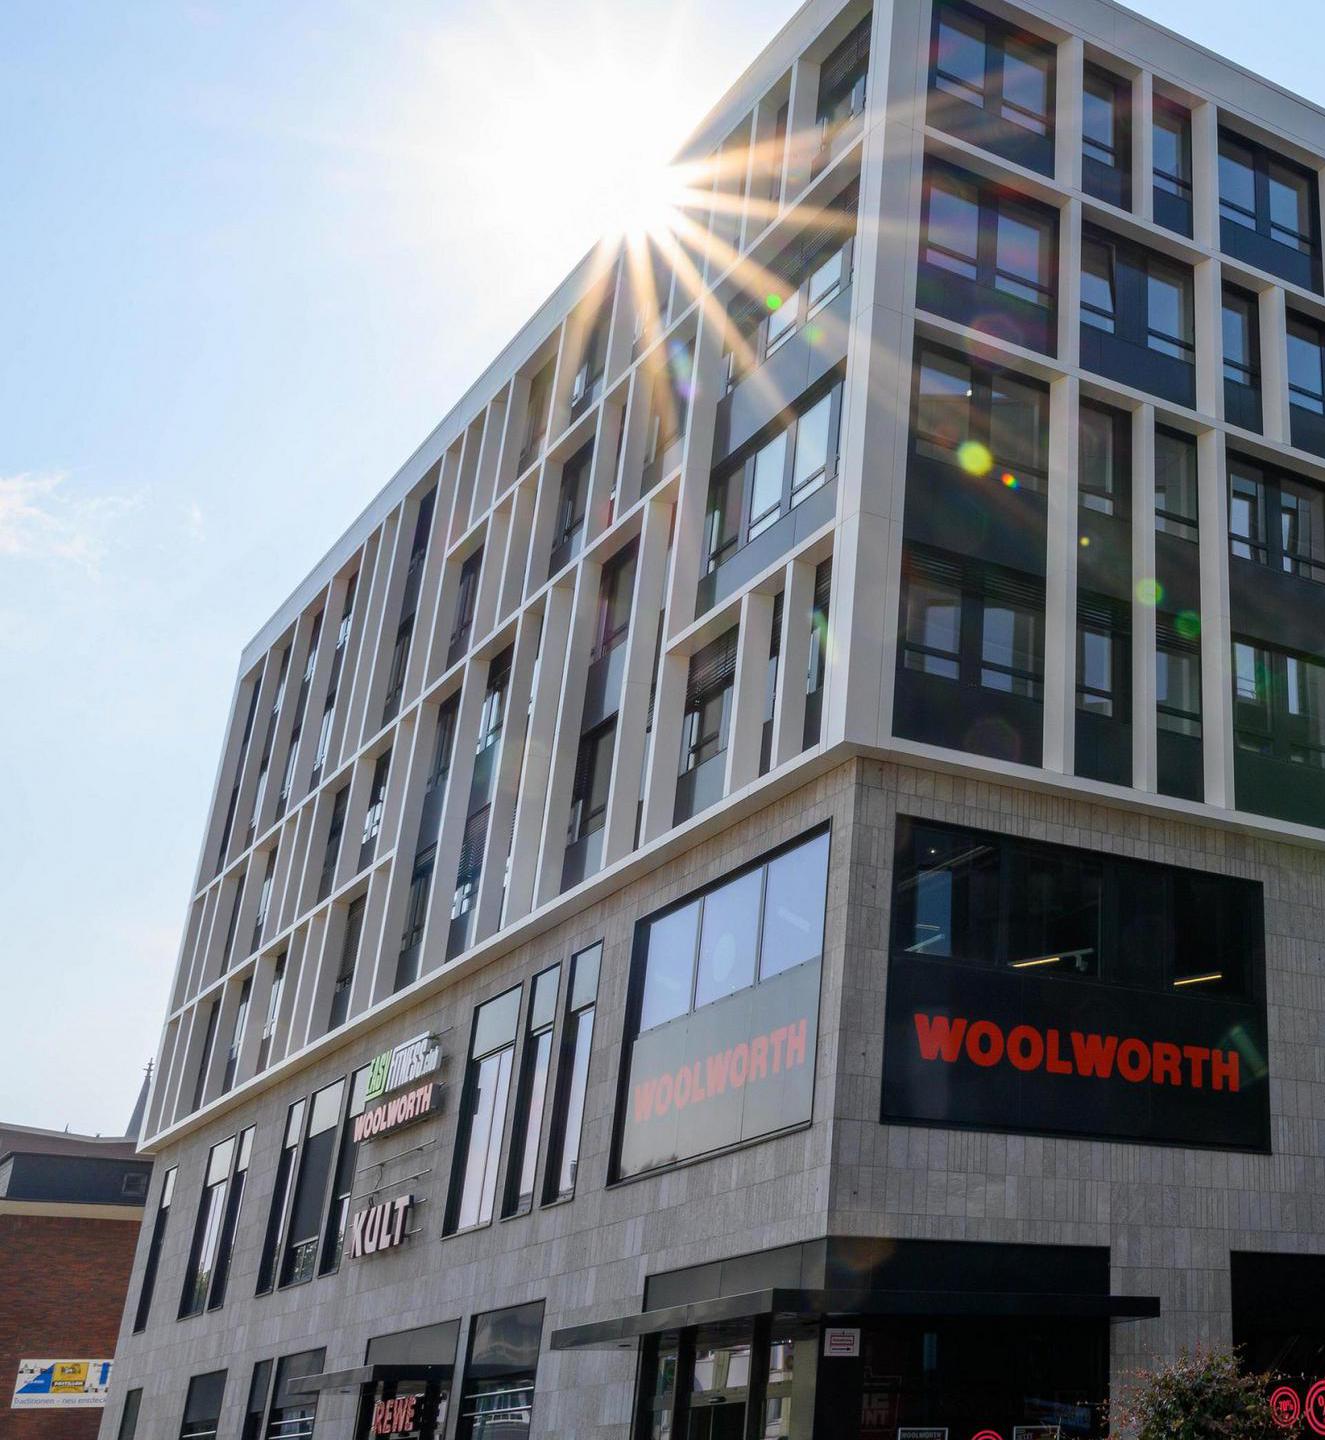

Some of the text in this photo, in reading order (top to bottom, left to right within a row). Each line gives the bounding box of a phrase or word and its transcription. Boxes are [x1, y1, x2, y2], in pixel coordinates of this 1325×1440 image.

[634, 1018, 807, 1122] WOOLWORTH
[914, 1013, 1240, 1092] WOOLWORTH
[353, 1083, 433, 1143] WOOLWORTH
[351, 1195, 411, 1259] KULT
[371, 1394, 417, 1435] REWE
